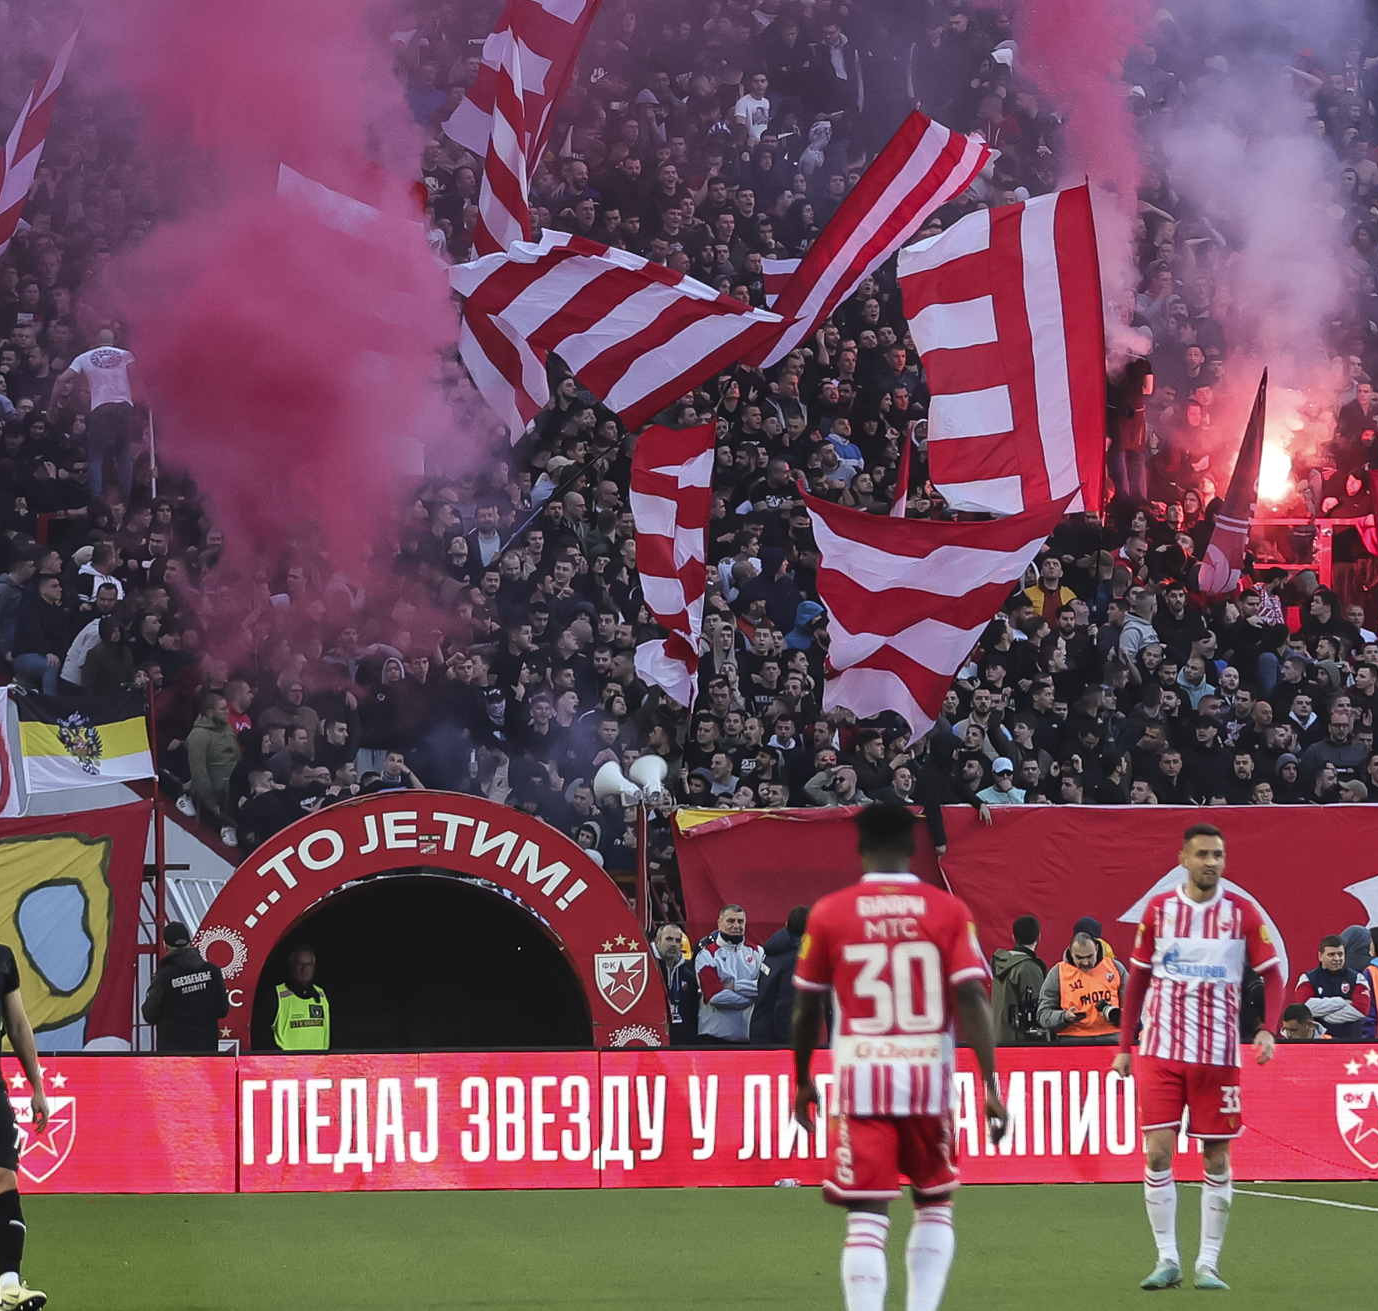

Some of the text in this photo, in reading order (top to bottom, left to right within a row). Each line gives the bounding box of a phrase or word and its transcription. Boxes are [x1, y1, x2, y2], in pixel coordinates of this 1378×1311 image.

[359, 810, 419, 855] ЈЕ
[433, 811, 589, 912] ТИМ!
[843, 940, 944, 1034] 30
[242, 1077, 439, 1173] ГЛЕДАЈ
[461, 1074, 667, 1170] ЗВЕЗДУ
[689, 1074, 719, 1161] У
[1219, 1085, 1241, 1114] 33
